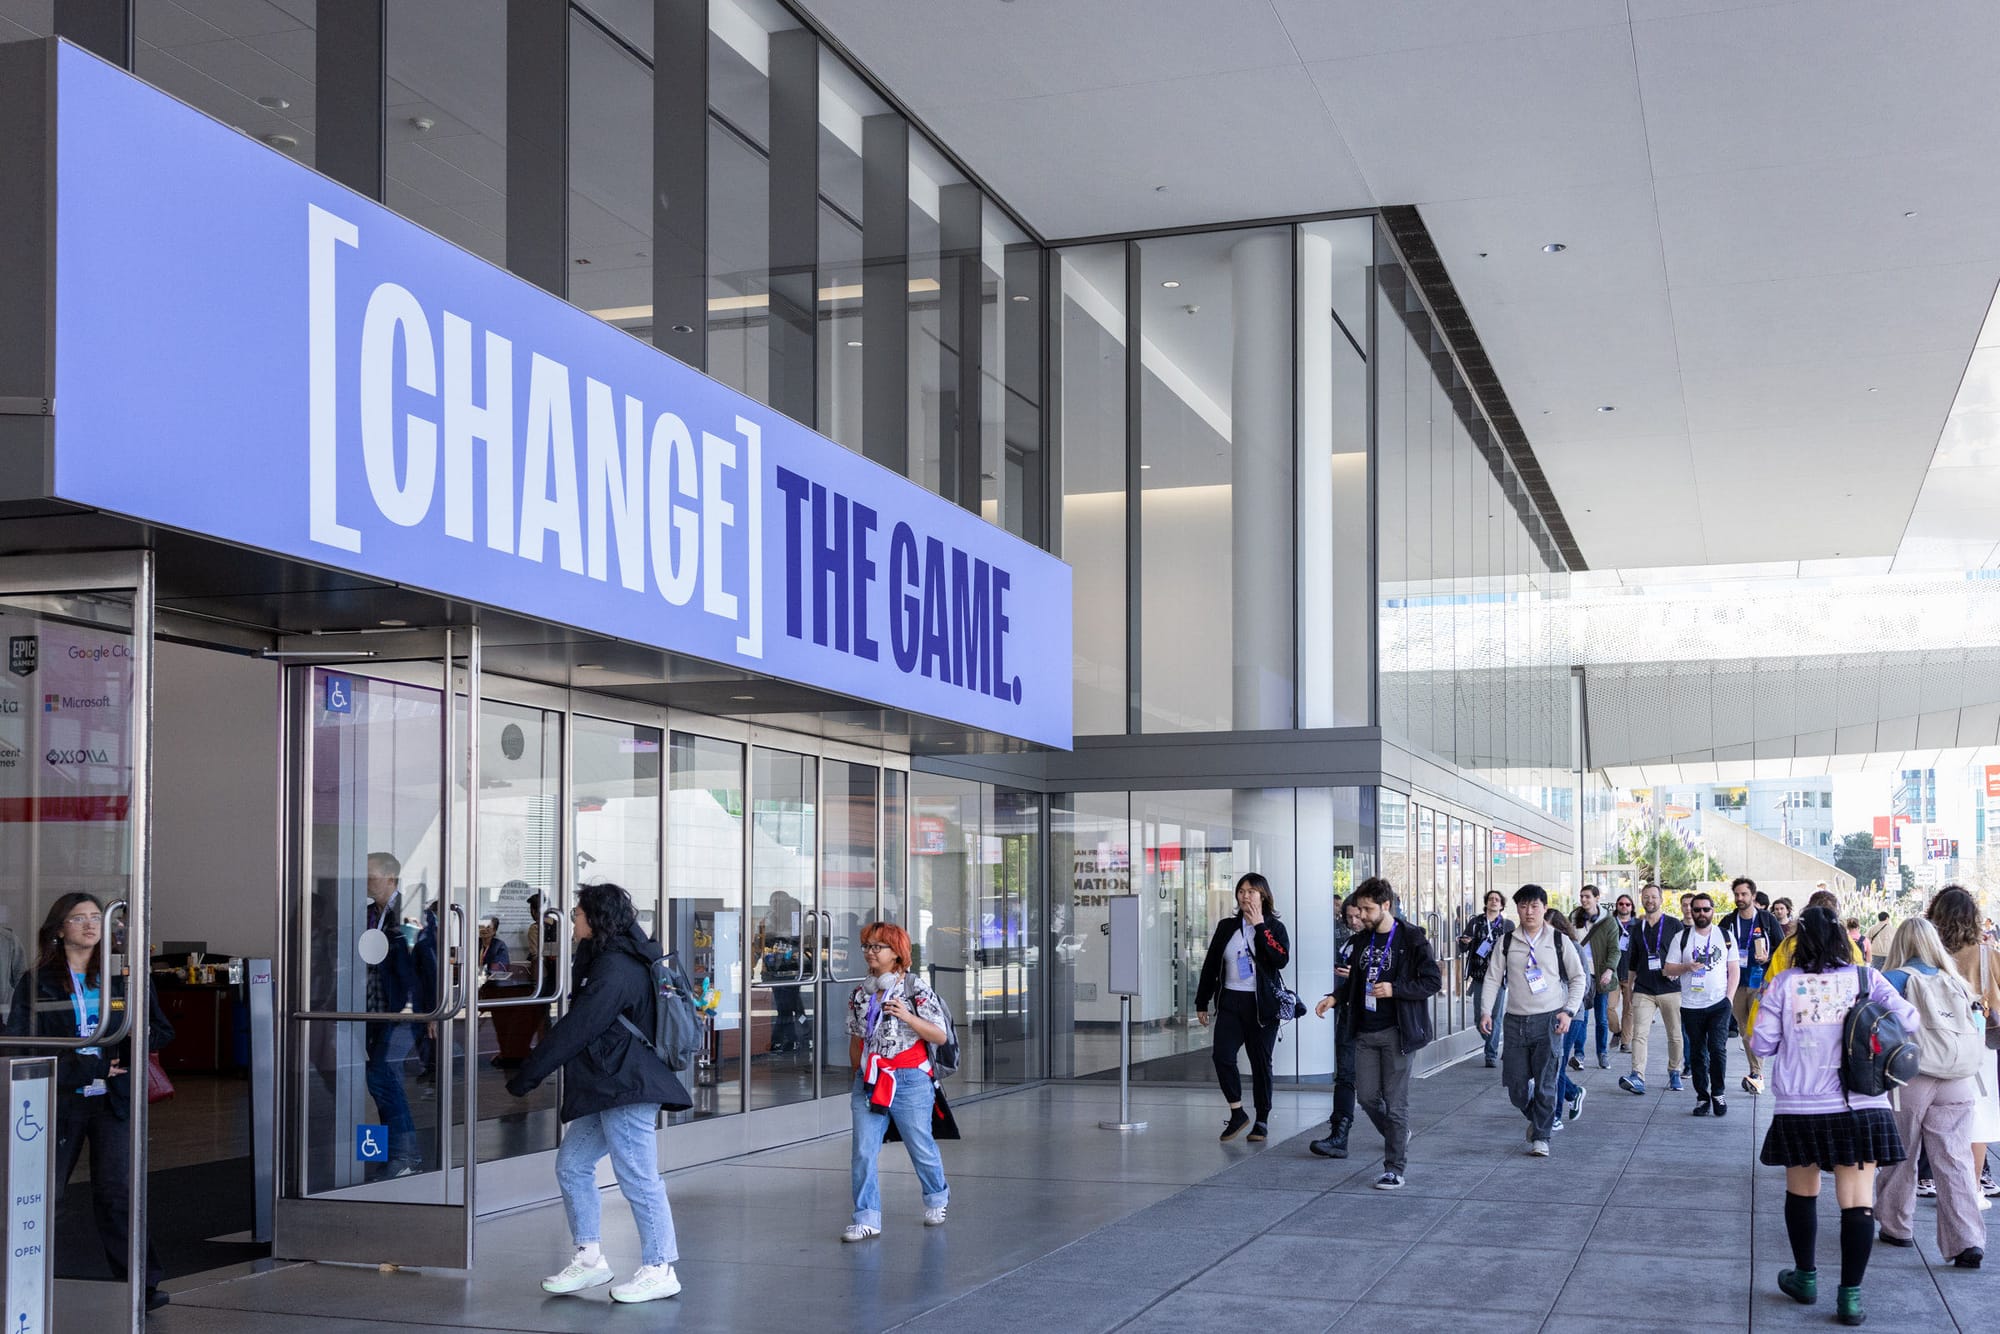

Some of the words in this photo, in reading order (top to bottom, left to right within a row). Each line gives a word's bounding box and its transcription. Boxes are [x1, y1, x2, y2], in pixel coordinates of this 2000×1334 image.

[777, 465, 878, 662] THE
[889, 521, 1022, 705] GAME.
[12, 640, 35, 658] EPIC
[68, 645, 110, 661] Google
[62, 695, 110, 708] Microsoft
[16, 1194, 42, 1206] PUSH
[22, 1220, 36, 1231] TO
[14, 1245, 42, 1258] OPEN
